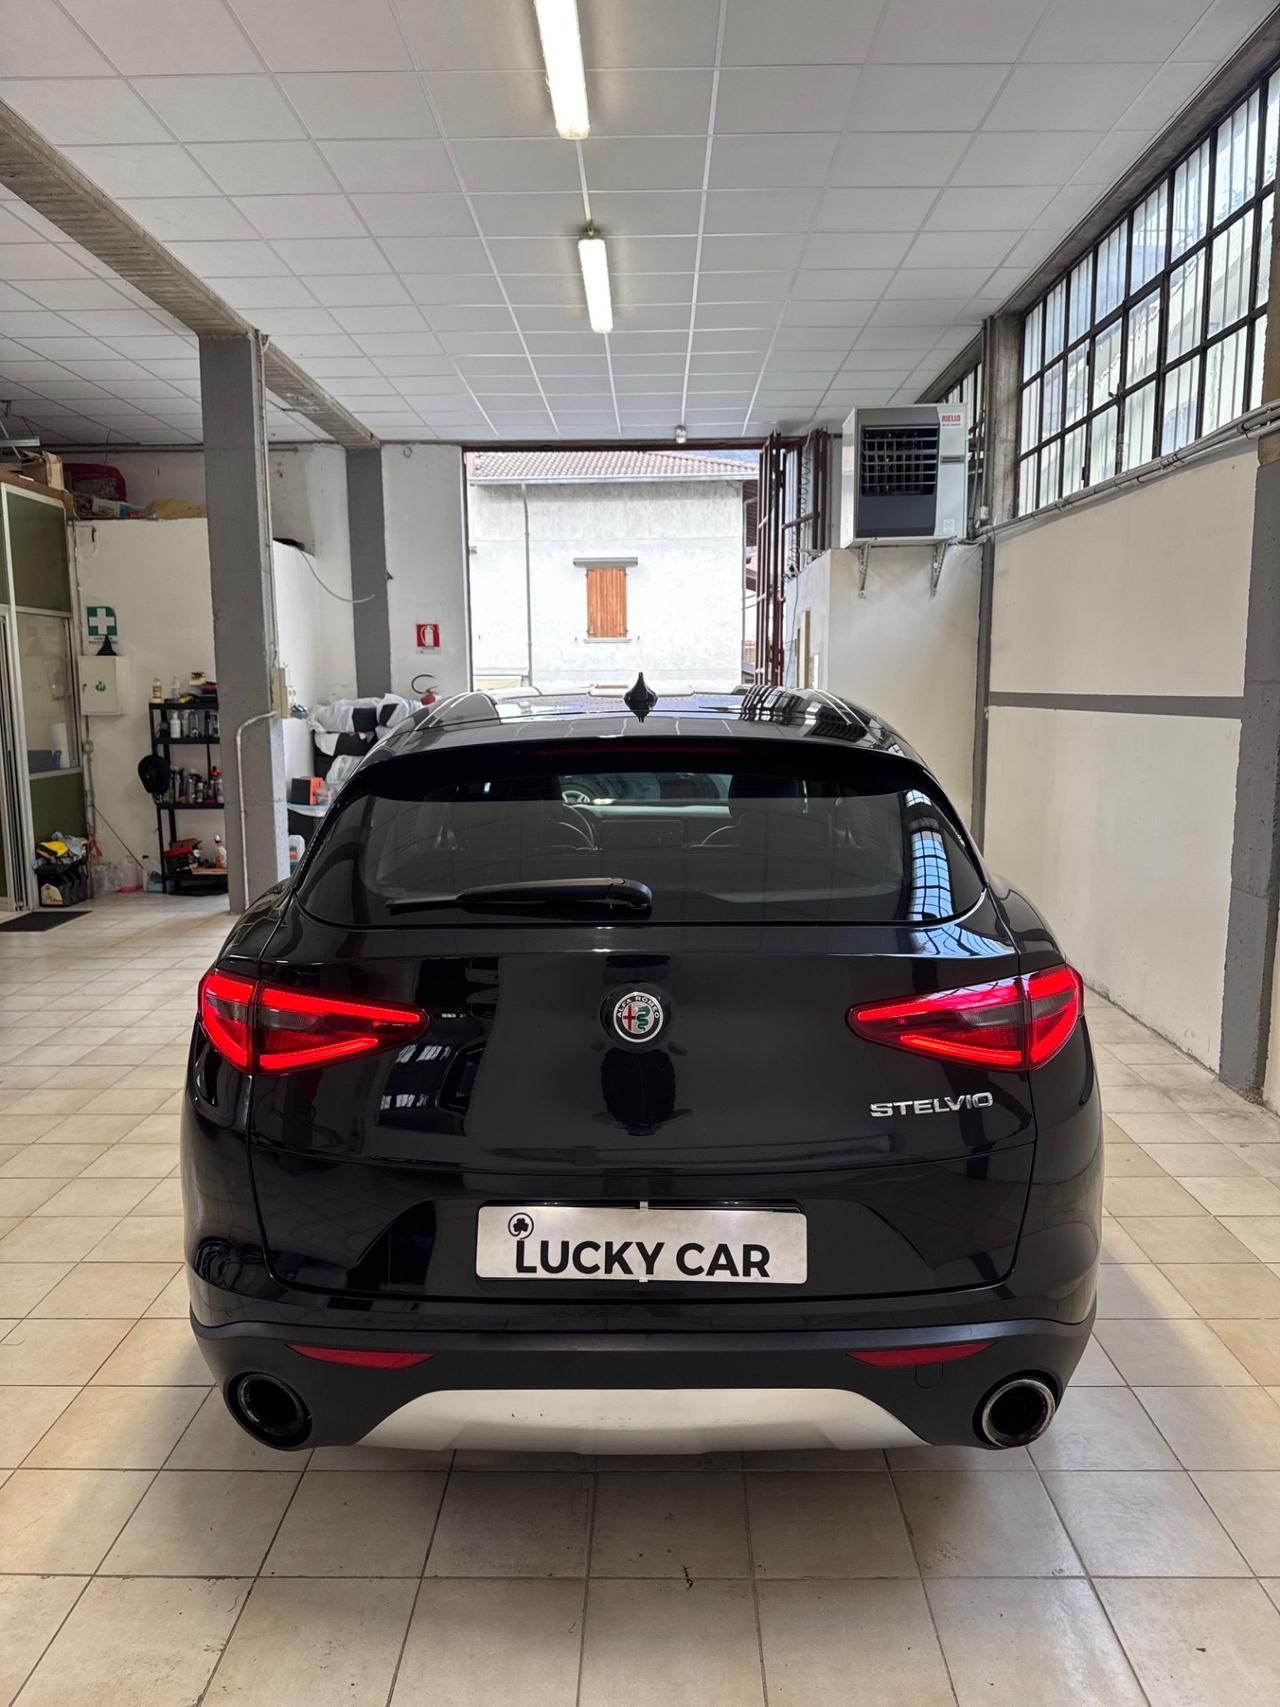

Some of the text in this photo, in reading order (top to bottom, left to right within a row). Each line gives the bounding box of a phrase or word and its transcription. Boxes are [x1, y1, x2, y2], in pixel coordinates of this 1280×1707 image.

[617, 995, 660, 1019] ALFA ROMEO
[870, 1092, 993, 1117] STELVIO
[515, 1240, 770, 1278] LUCKY CAR
